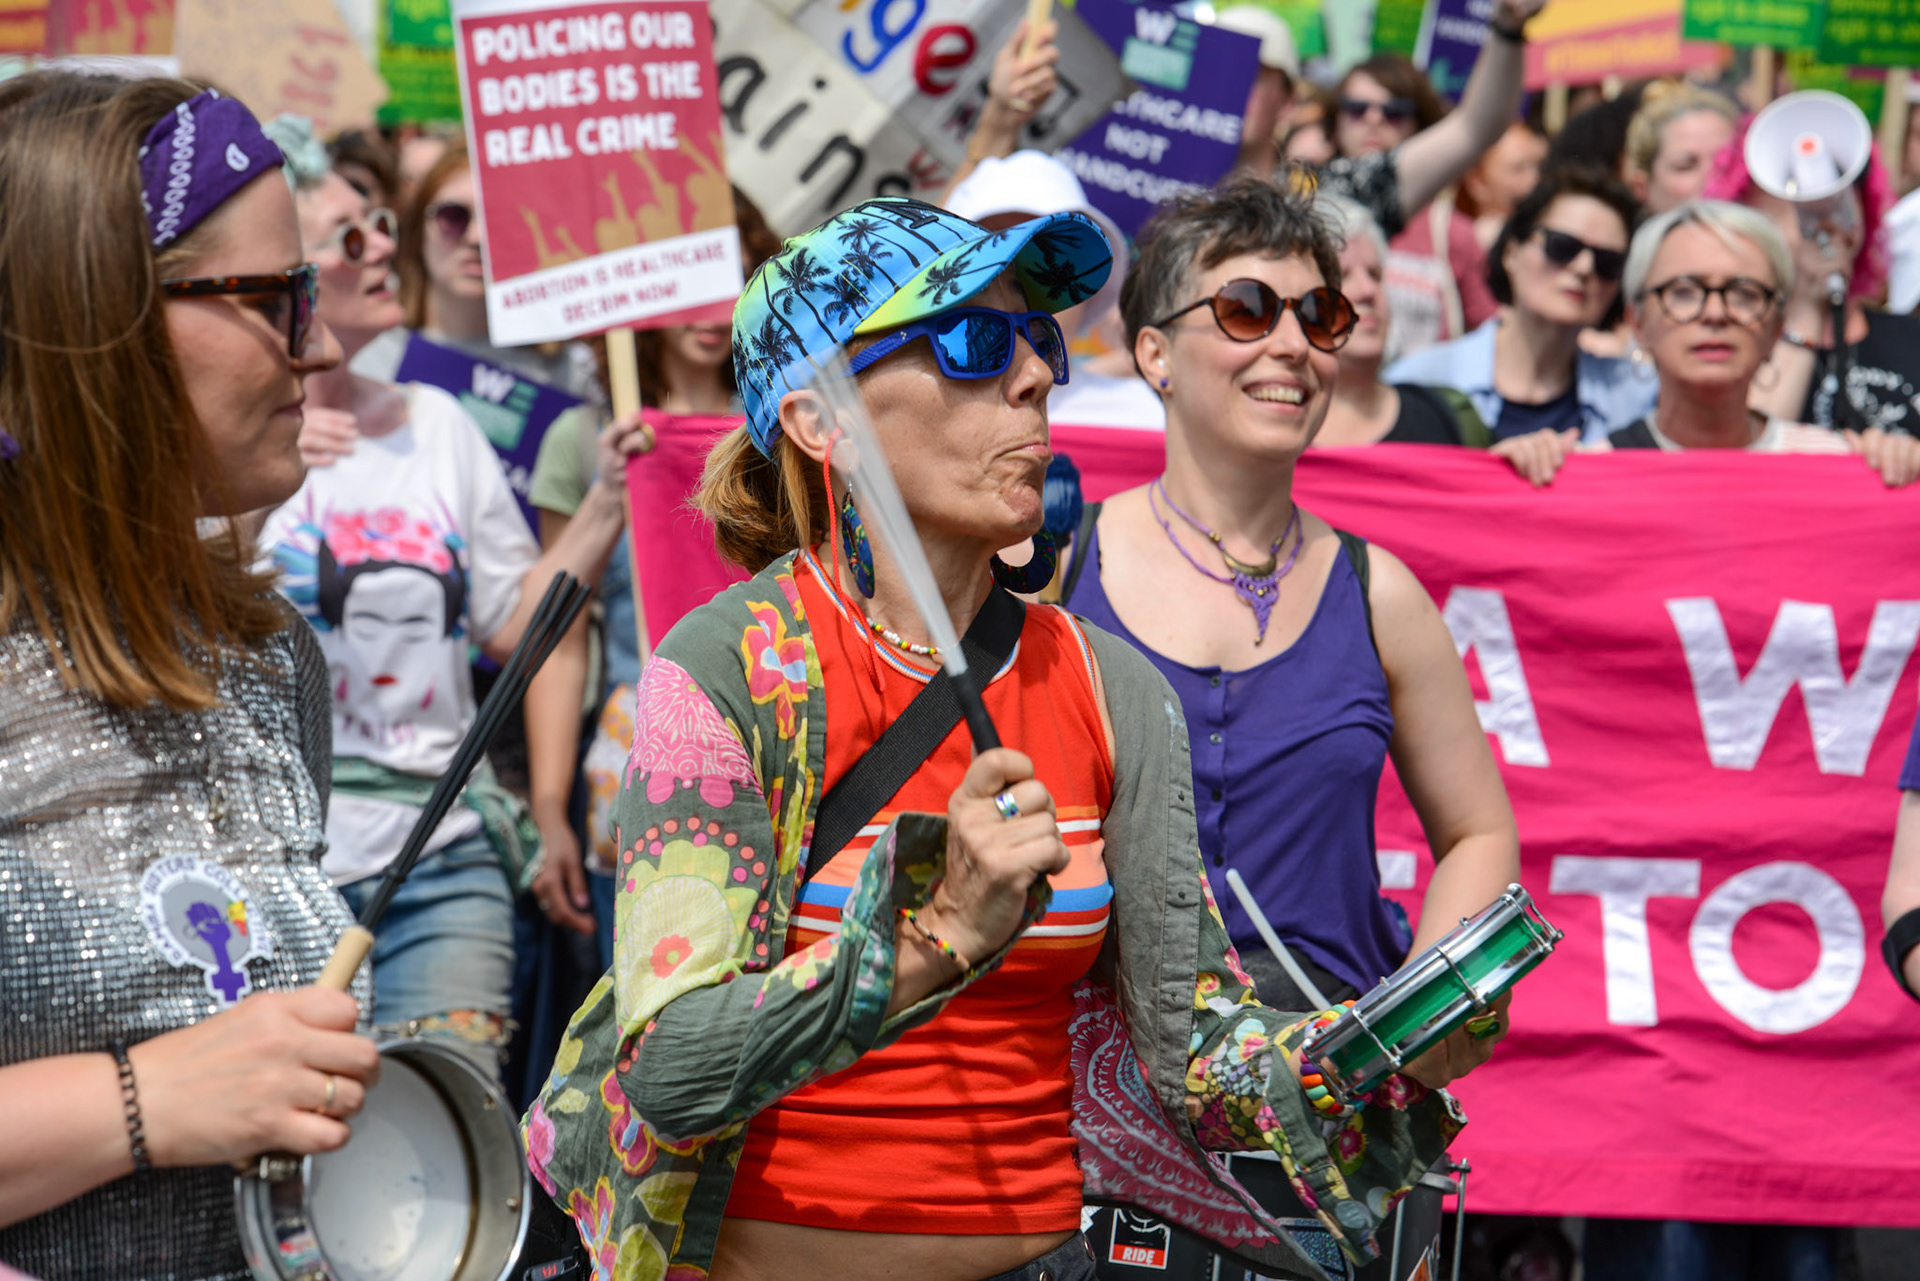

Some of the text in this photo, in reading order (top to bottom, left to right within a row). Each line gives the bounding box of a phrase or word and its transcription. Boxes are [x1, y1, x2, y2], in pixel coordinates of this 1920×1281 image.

[472, 11, 695, 66] POLICING OUR
[478, 67, 599, 116] BODIES
[604, 64, 638, 101] IS
[642, 61, 703, 99] THE
[484, 112, 680, 168] REAL CRIME
[1104, 122, 1171, 164] NOT
[1113, 91, 1242, 145] THCARE
[502, 274, 590, 310] ABORTION
[611, 239, 727, 280] HEALTHCARE
[561, 291, 631, 323] DECRIM
[1549, 855, 1866, 1036] TO
[1122, 1246, 1156, 1266] RIDE
